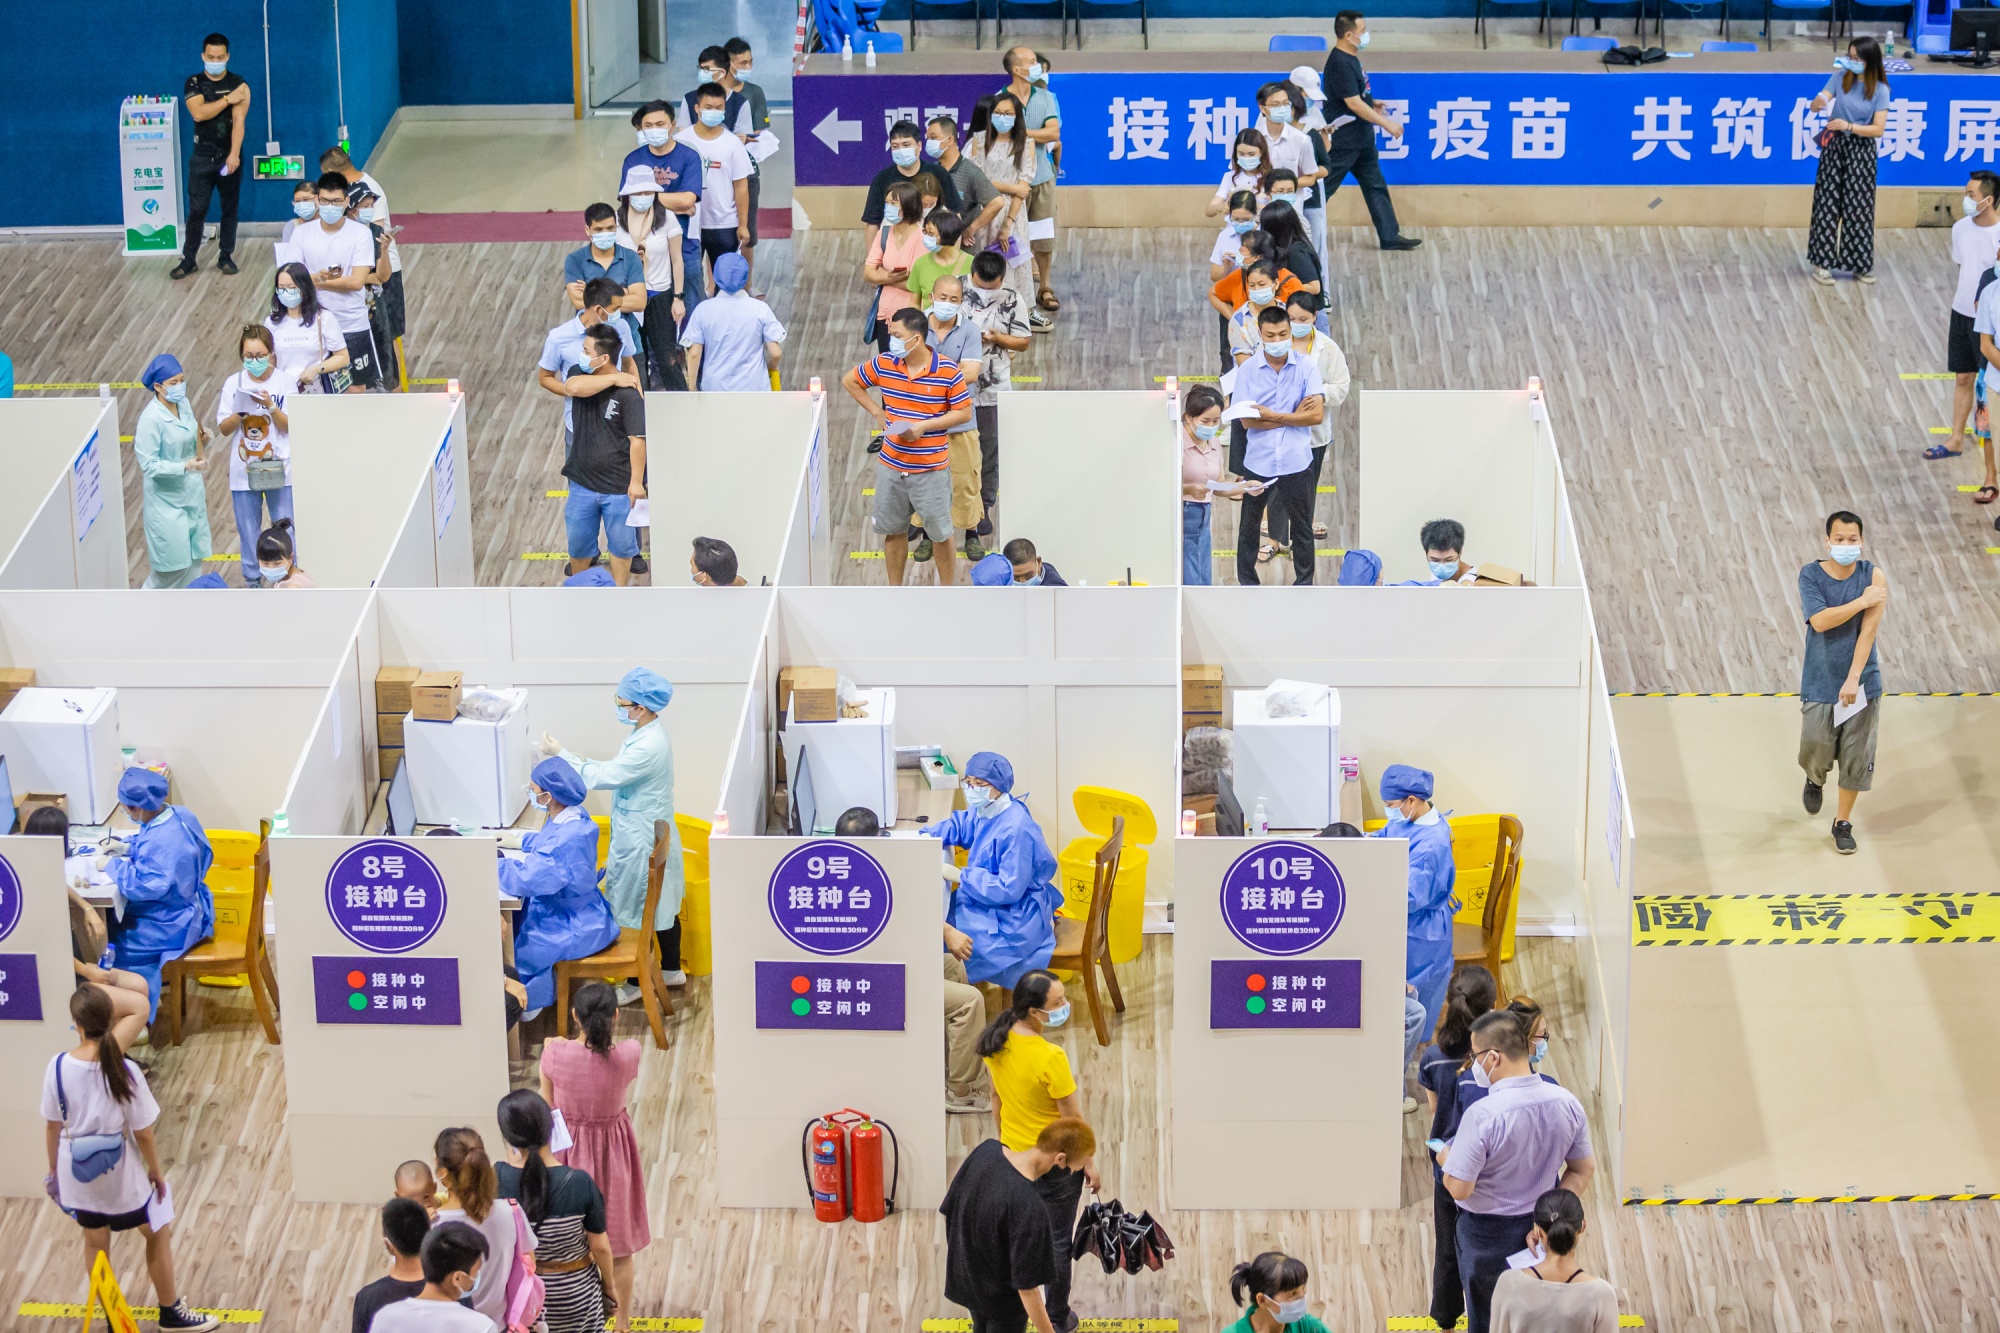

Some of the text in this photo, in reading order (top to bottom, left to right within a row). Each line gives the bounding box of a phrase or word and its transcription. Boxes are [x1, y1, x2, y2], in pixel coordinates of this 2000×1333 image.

[1108, 97, 1570, 160] 接种疫苗
[134, 167, 163, 178] 充电宝
[354, 354, 369, 370] 30
[362, 856, 406, 878] 8号
[807, 856, 852, 879] 9号
[1250, 857, 1314, 880] 10号
[345, 885, 426, 908] 接种台
[788, 885, 872, 909] 接种台
[1241, 886, 1324, 910] 接种台
[371, 972, 425, 988] 接种中
[816, 977, 871, 993] 接种中
[1271, 975, 1327, 990] 接种中
[373, 994, 427, 1010] 空闲中
[816, 1000, 871, 1016] 空闲中
[1271, 997, 1327, 1013] 空闲中
